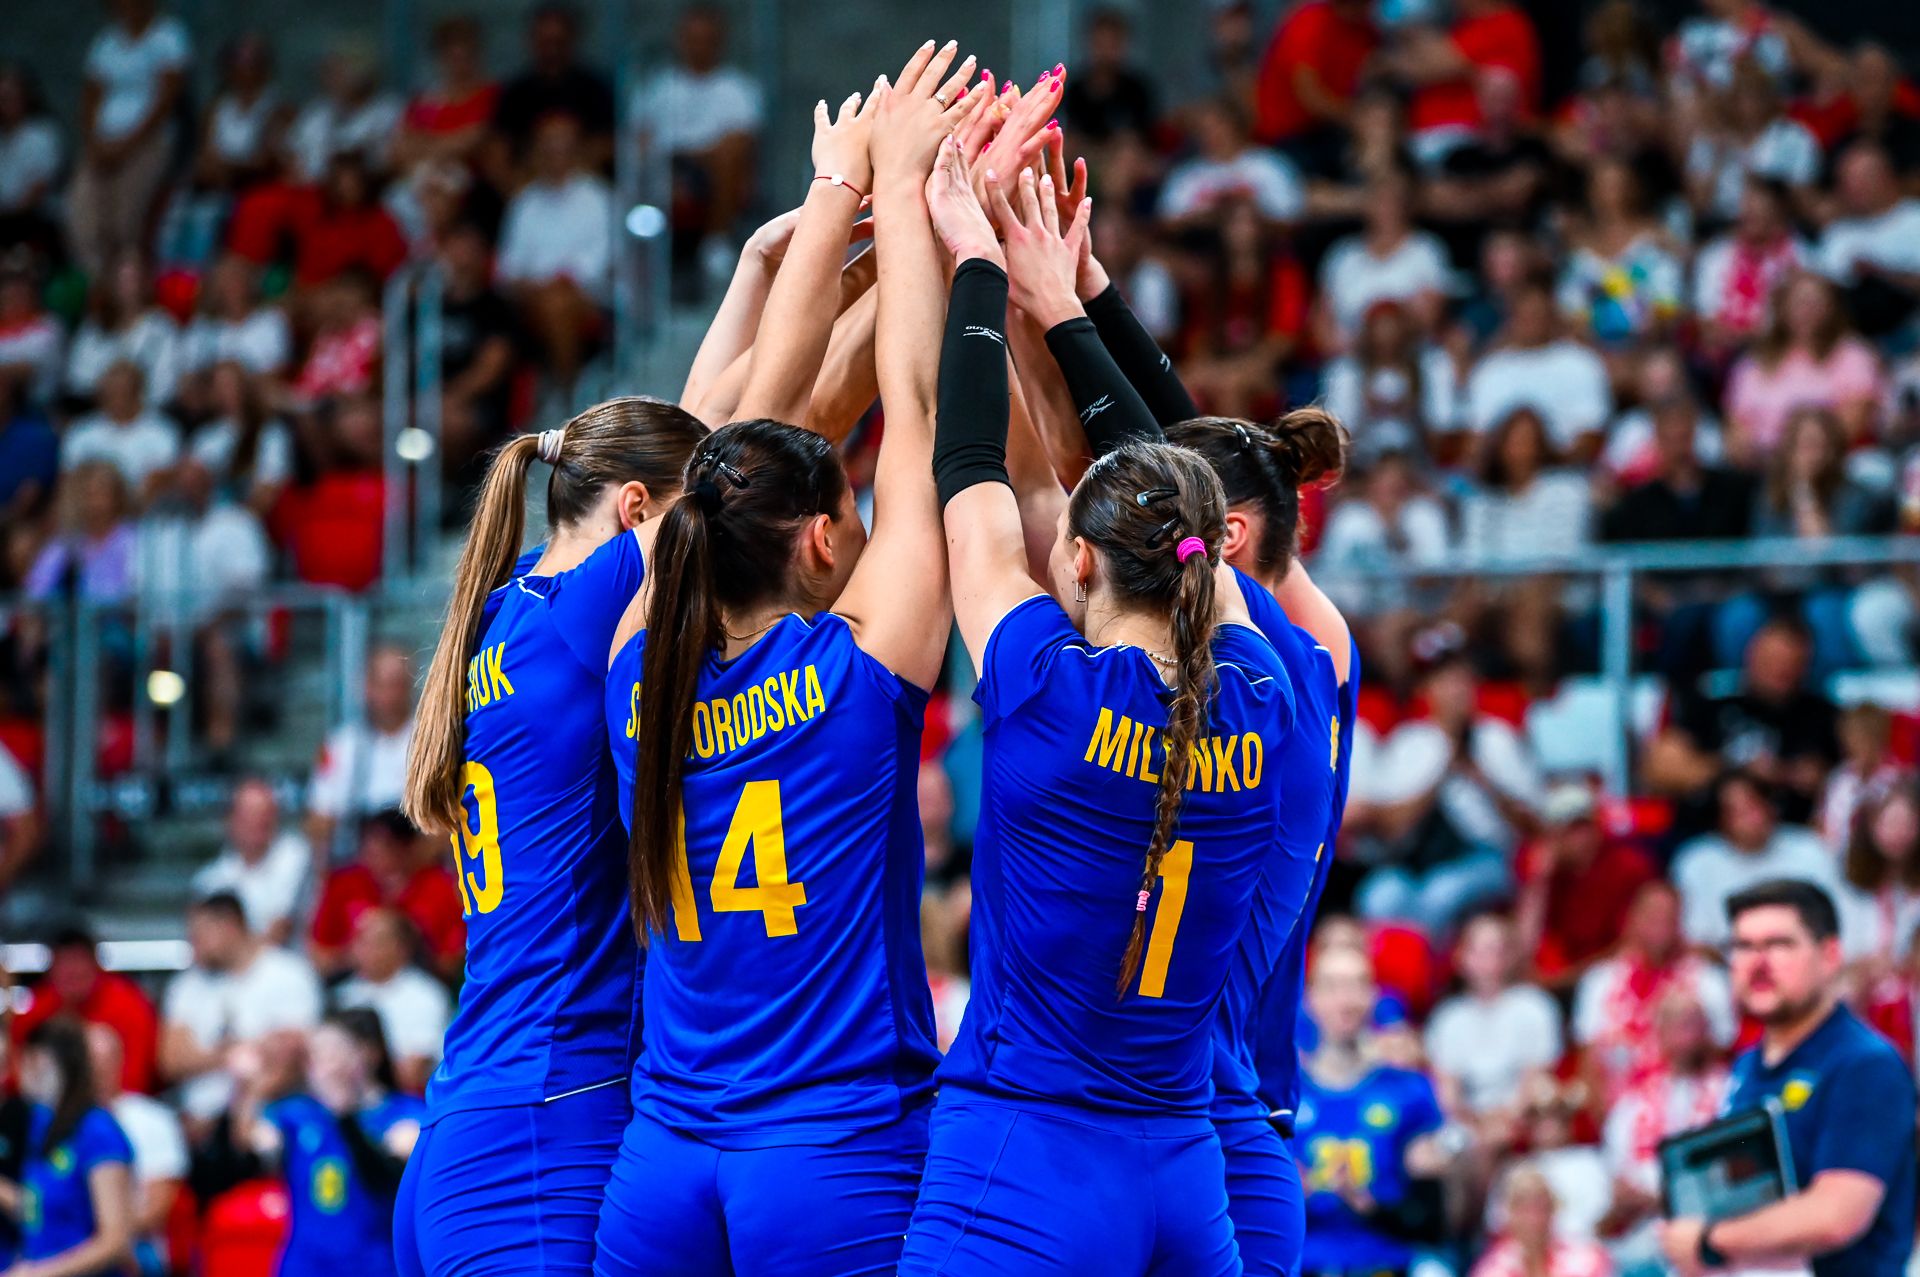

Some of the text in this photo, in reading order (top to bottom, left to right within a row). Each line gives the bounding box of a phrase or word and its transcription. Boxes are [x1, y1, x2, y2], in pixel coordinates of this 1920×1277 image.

[465, 641, 515, 713] HUK
[625, 664, 826, 760] SORODSKA
[1138, 839, 1195, 998] 1
